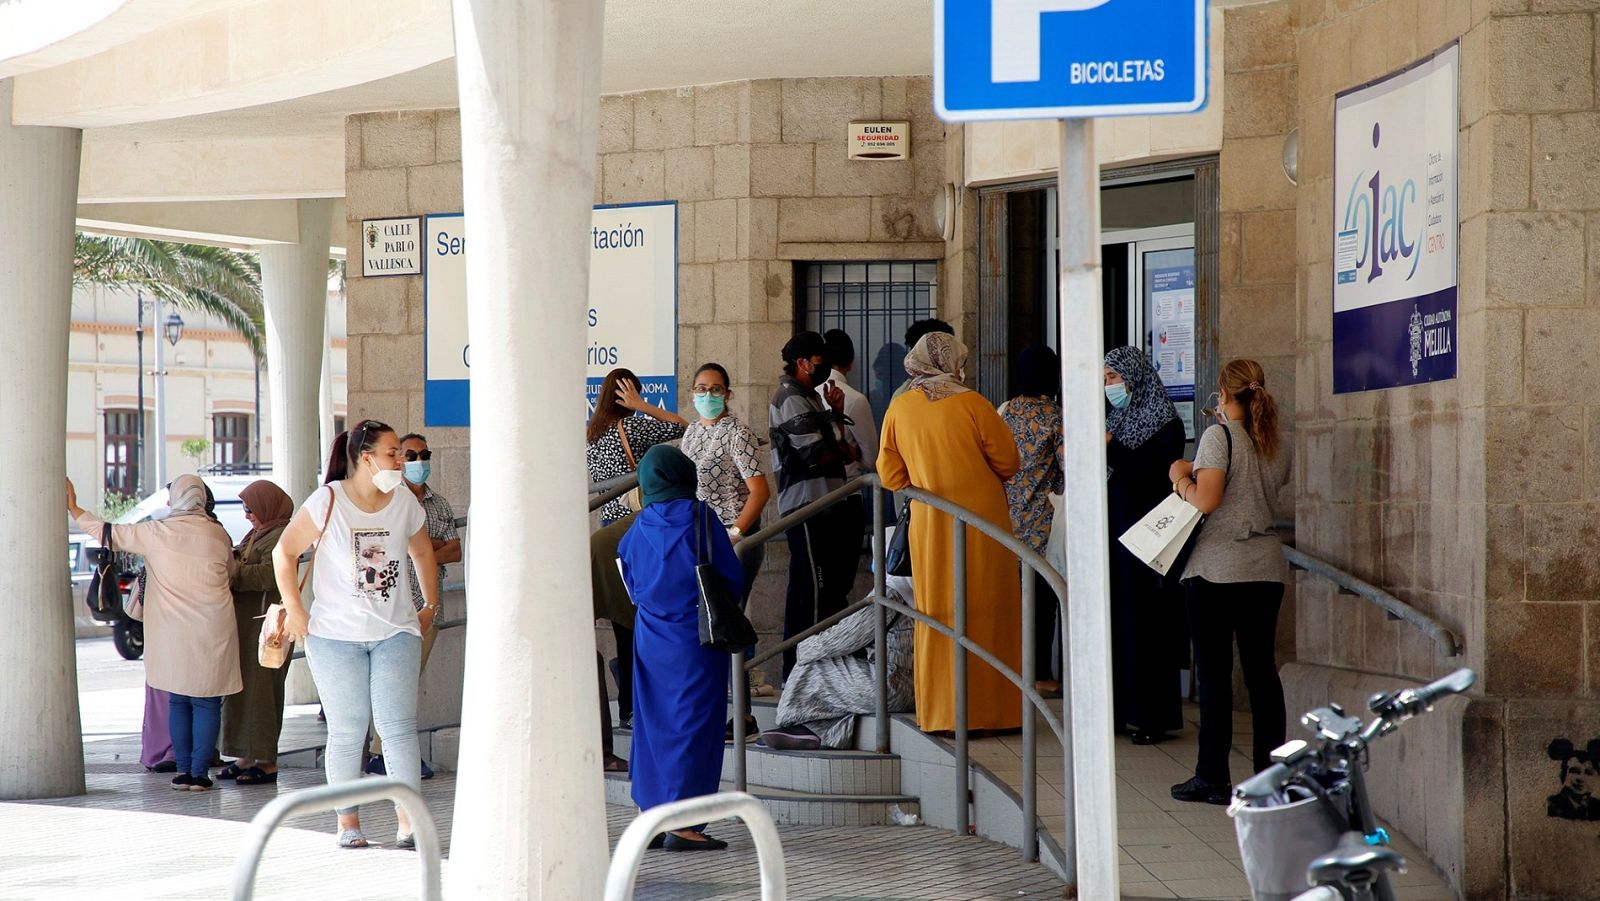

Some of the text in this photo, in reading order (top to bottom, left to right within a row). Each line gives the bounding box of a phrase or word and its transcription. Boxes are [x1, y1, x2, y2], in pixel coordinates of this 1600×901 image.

[1070, 59, 1165, 84] BICICLETAS
[384, 223, 413, 236] CALLE
[384, 240, 415, 253] PABLO
[437, 222, 644, 256] Ser tación
[368, 258, 414, 270] VALLESCA
[1424, 326, 1451, 357] MELILLA
[587, 341, 618, 365] rios
[641, 383, 669, 394] NOMA
